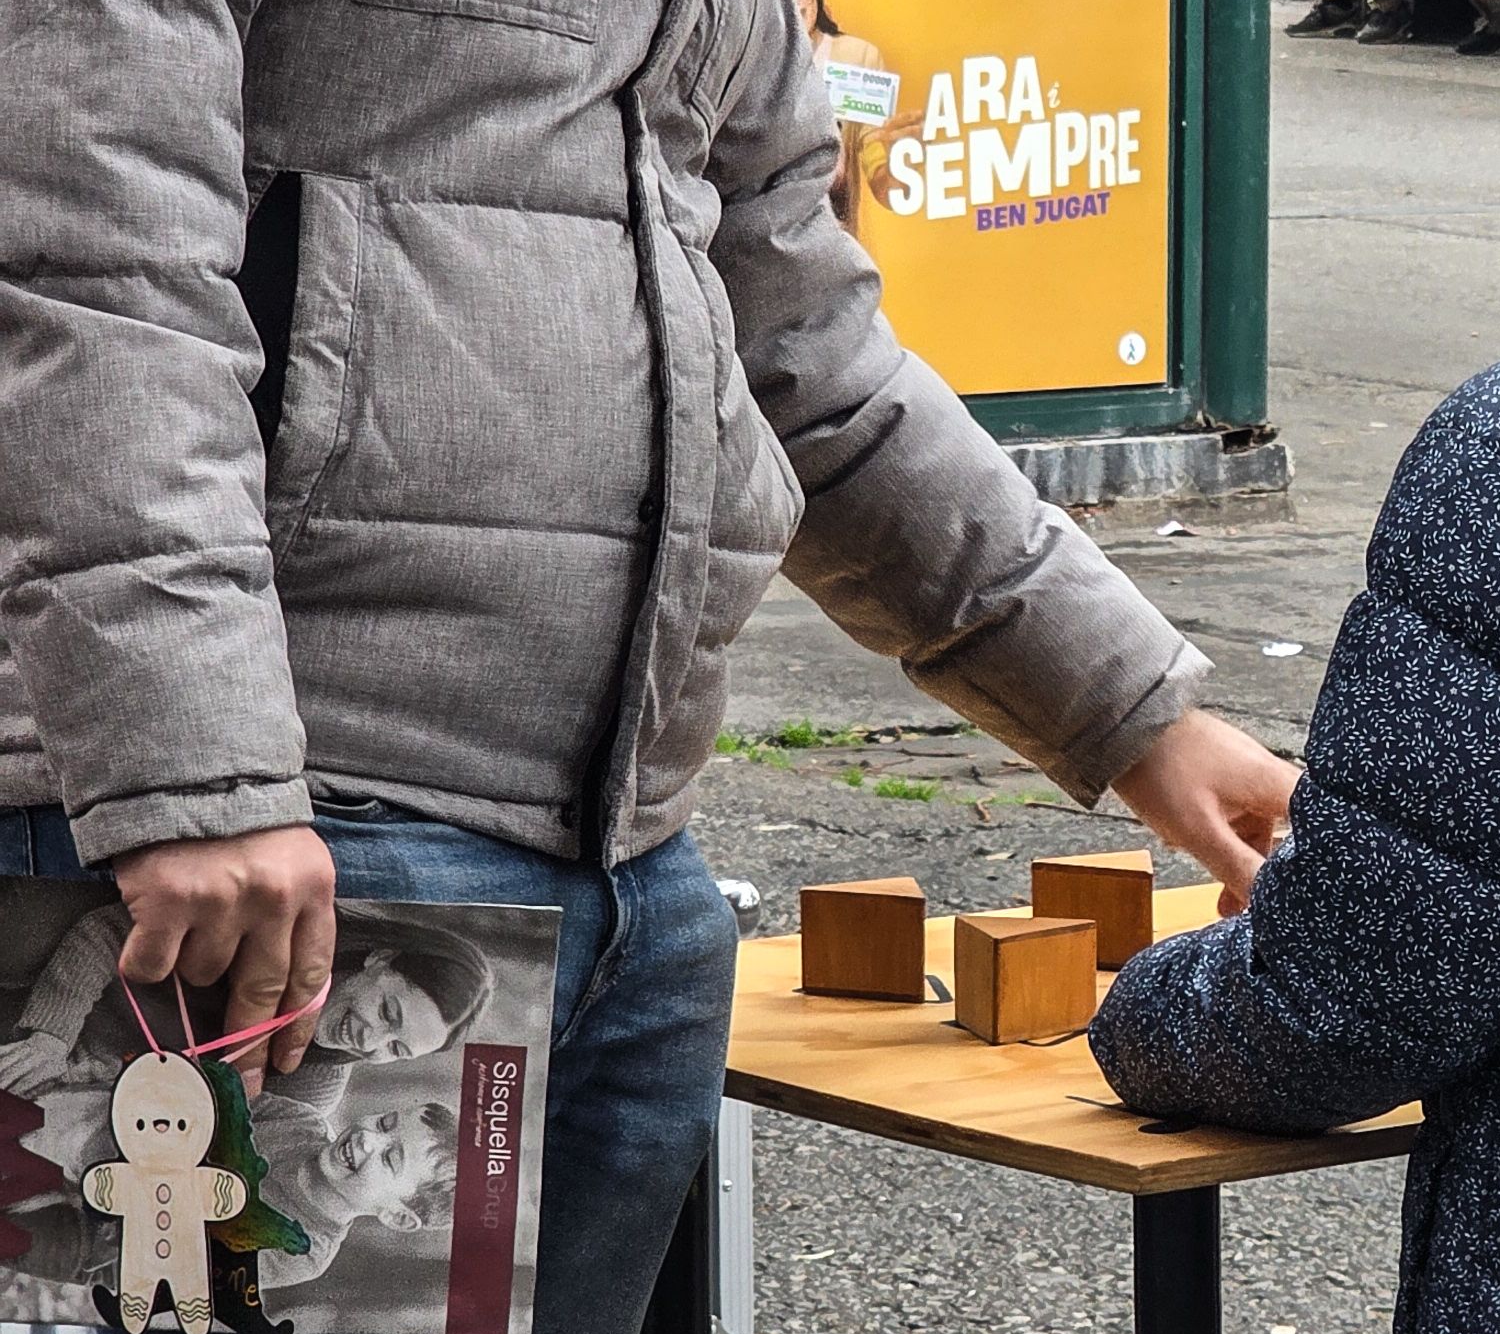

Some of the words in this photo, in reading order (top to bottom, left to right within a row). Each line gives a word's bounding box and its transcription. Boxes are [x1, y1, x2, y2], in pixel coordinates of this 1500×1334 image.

[923, 56, 1046, 141] ARA
[888, 109, 1141, 220] SEMPRE
[977, 203, 1026, 231] BEN
[1034, 192, 1111, 225] JUGAT
